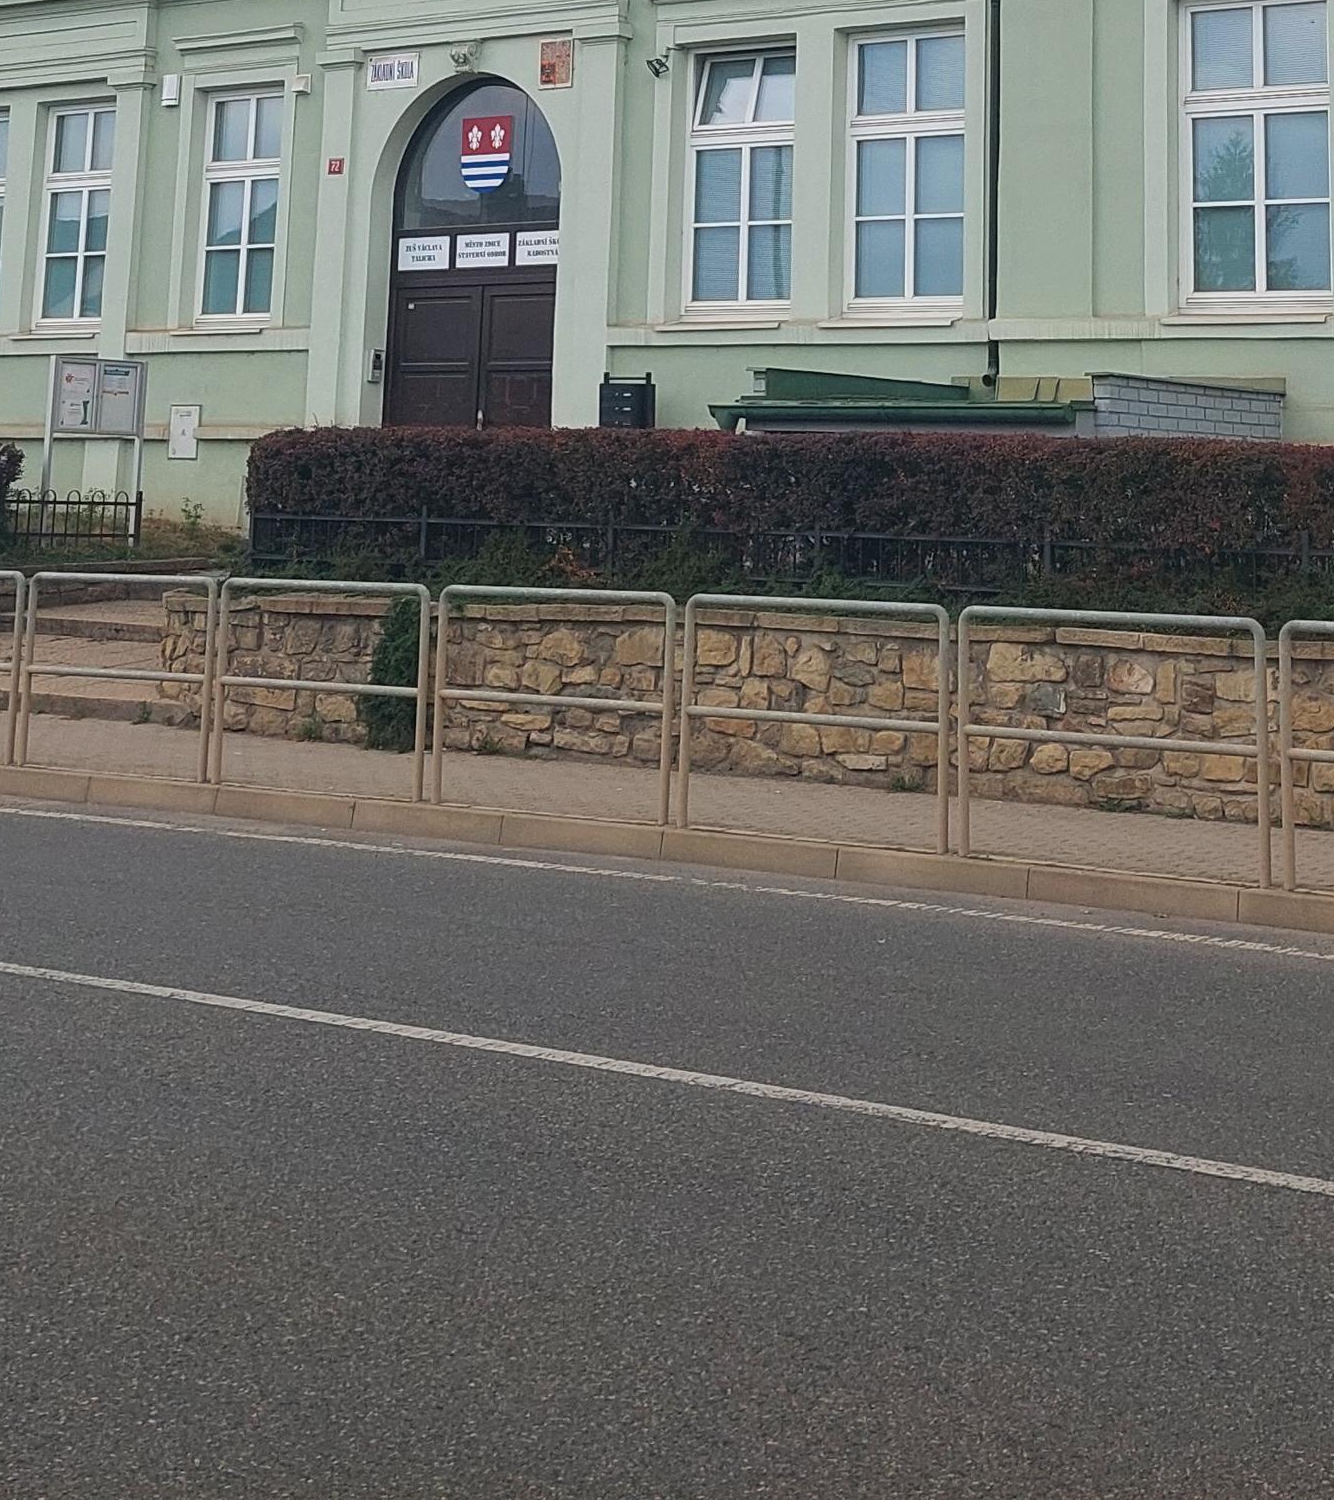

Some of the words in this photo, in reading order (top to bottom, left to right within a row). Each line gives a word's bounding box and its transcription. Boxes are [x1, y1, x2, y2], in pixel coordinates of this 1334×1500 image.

[370, 60, 396, 83] ZÁKLADNÍ
[397, 59, 414, 80] ŠKOLA
[330, 160, 340, 172] 72
[464, 240, 483, 248] MĚSTO
[517, 238, 548, 247] ZÁKLADNÍ
